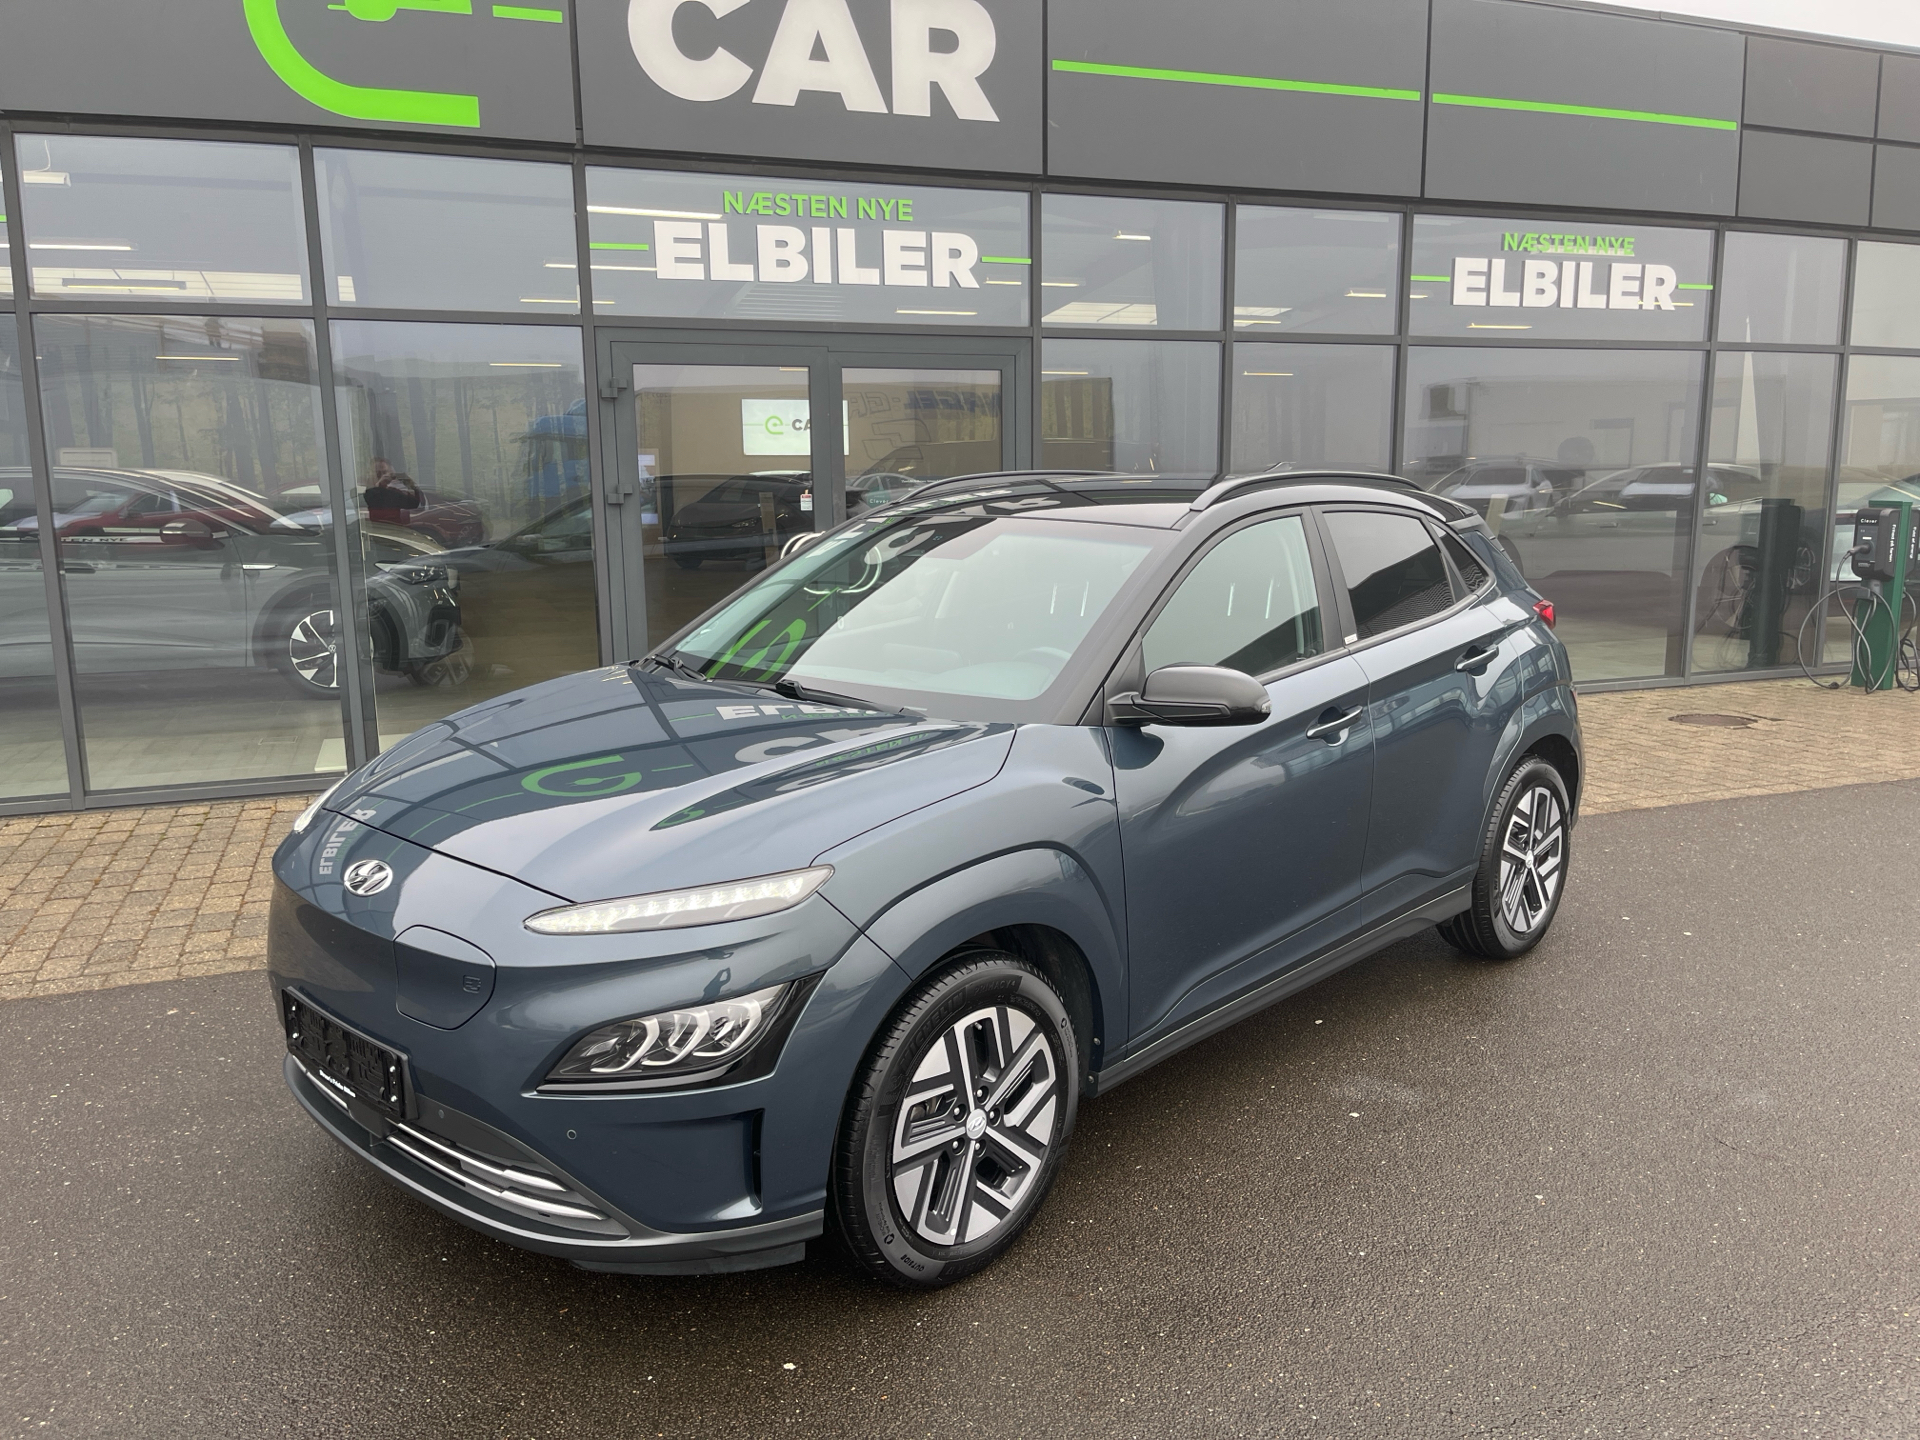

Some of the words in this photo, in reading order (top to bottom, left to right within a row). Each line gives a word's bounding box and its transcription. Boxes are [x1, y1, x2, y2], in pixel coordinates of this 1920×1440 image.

[628, 0, 1000, 122] CAR
[723, 190, 847, 219] NÆSTEN
[858, 196, 913, 222] NYE
[653, 220, 980, 289] ELBILER
[1503, 232, 1590, 253] NÆSTEN
[1596, 236, 1635, 255] NYE
[1452, 256, 1676, 310] ELBILER
[791, 418, 811, 431] CA
[900, 1253, 925, 1272] OUTSIDE
